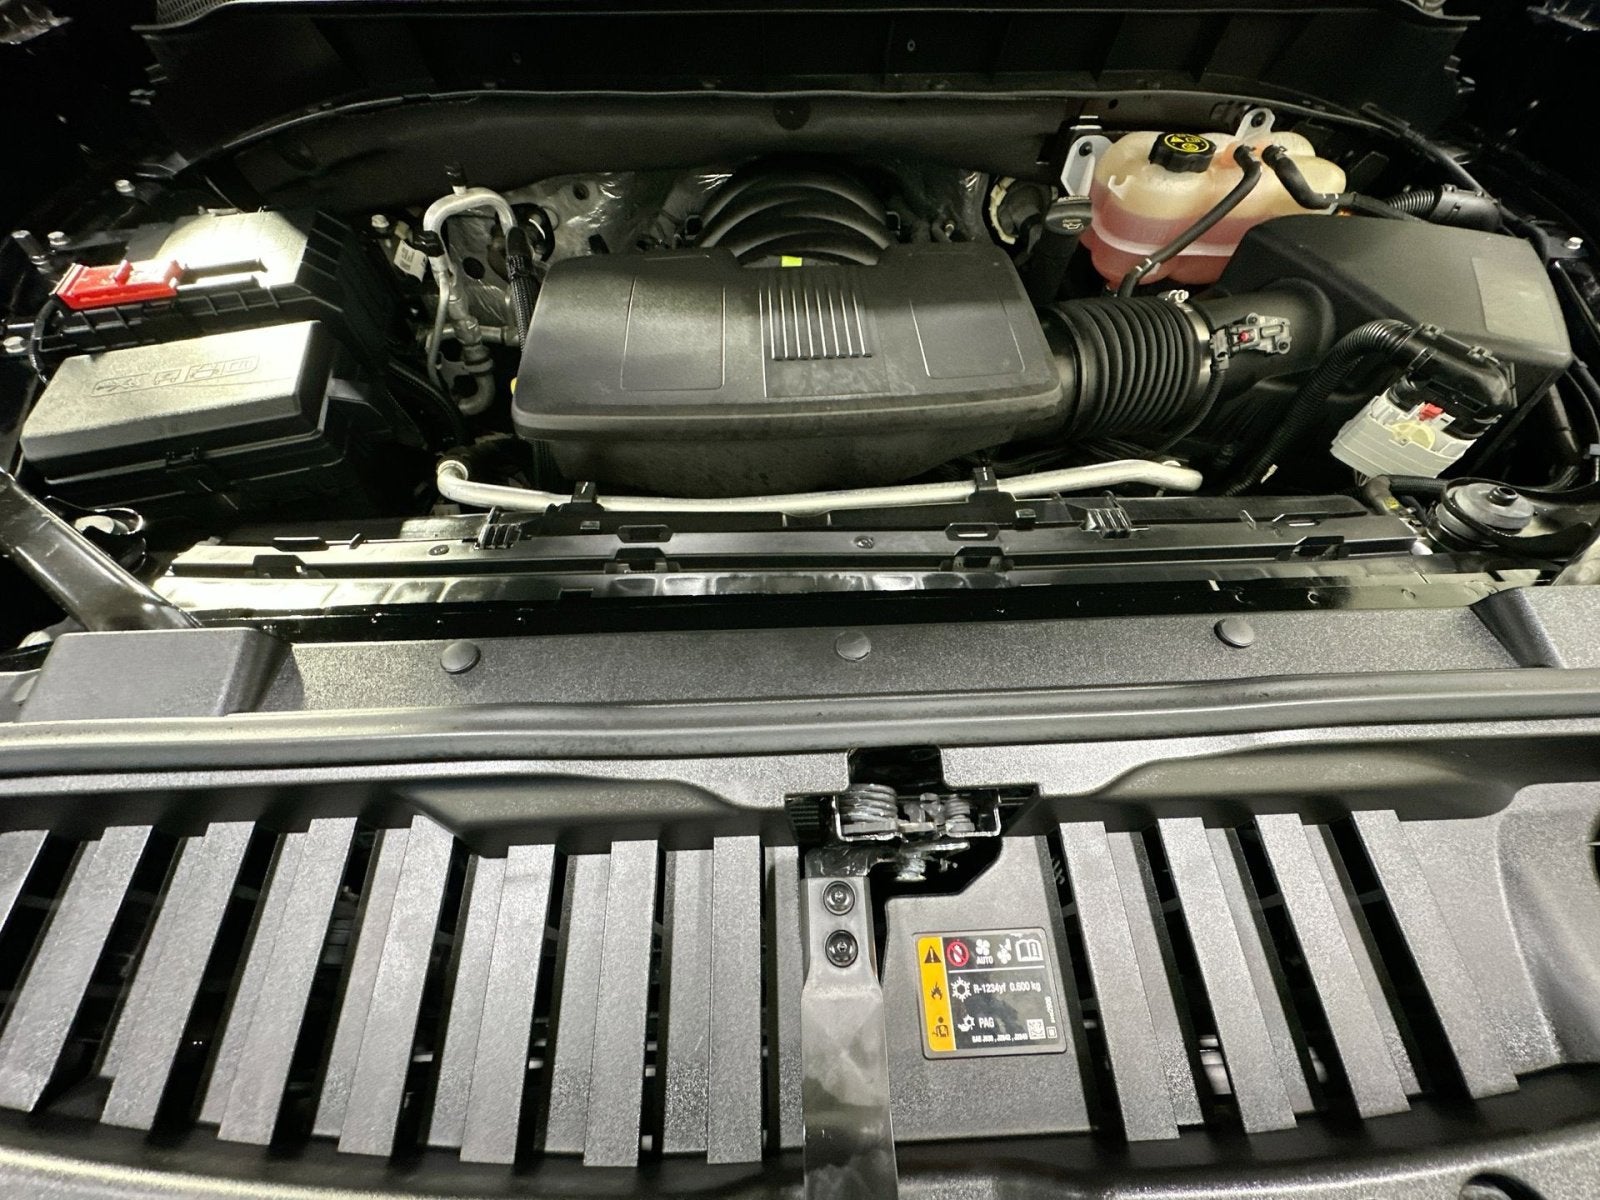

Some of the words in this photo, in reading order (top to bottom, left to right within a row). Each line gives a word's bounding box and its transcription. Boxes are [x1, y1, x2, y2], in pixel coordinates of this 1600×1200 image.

[976, 955, 994, 965] AUTO
[973, 982, 1006, 995] R-1234yf
[1030, 980, 1041, 993] kg
[978, 1016, 995, 1028] PAG
